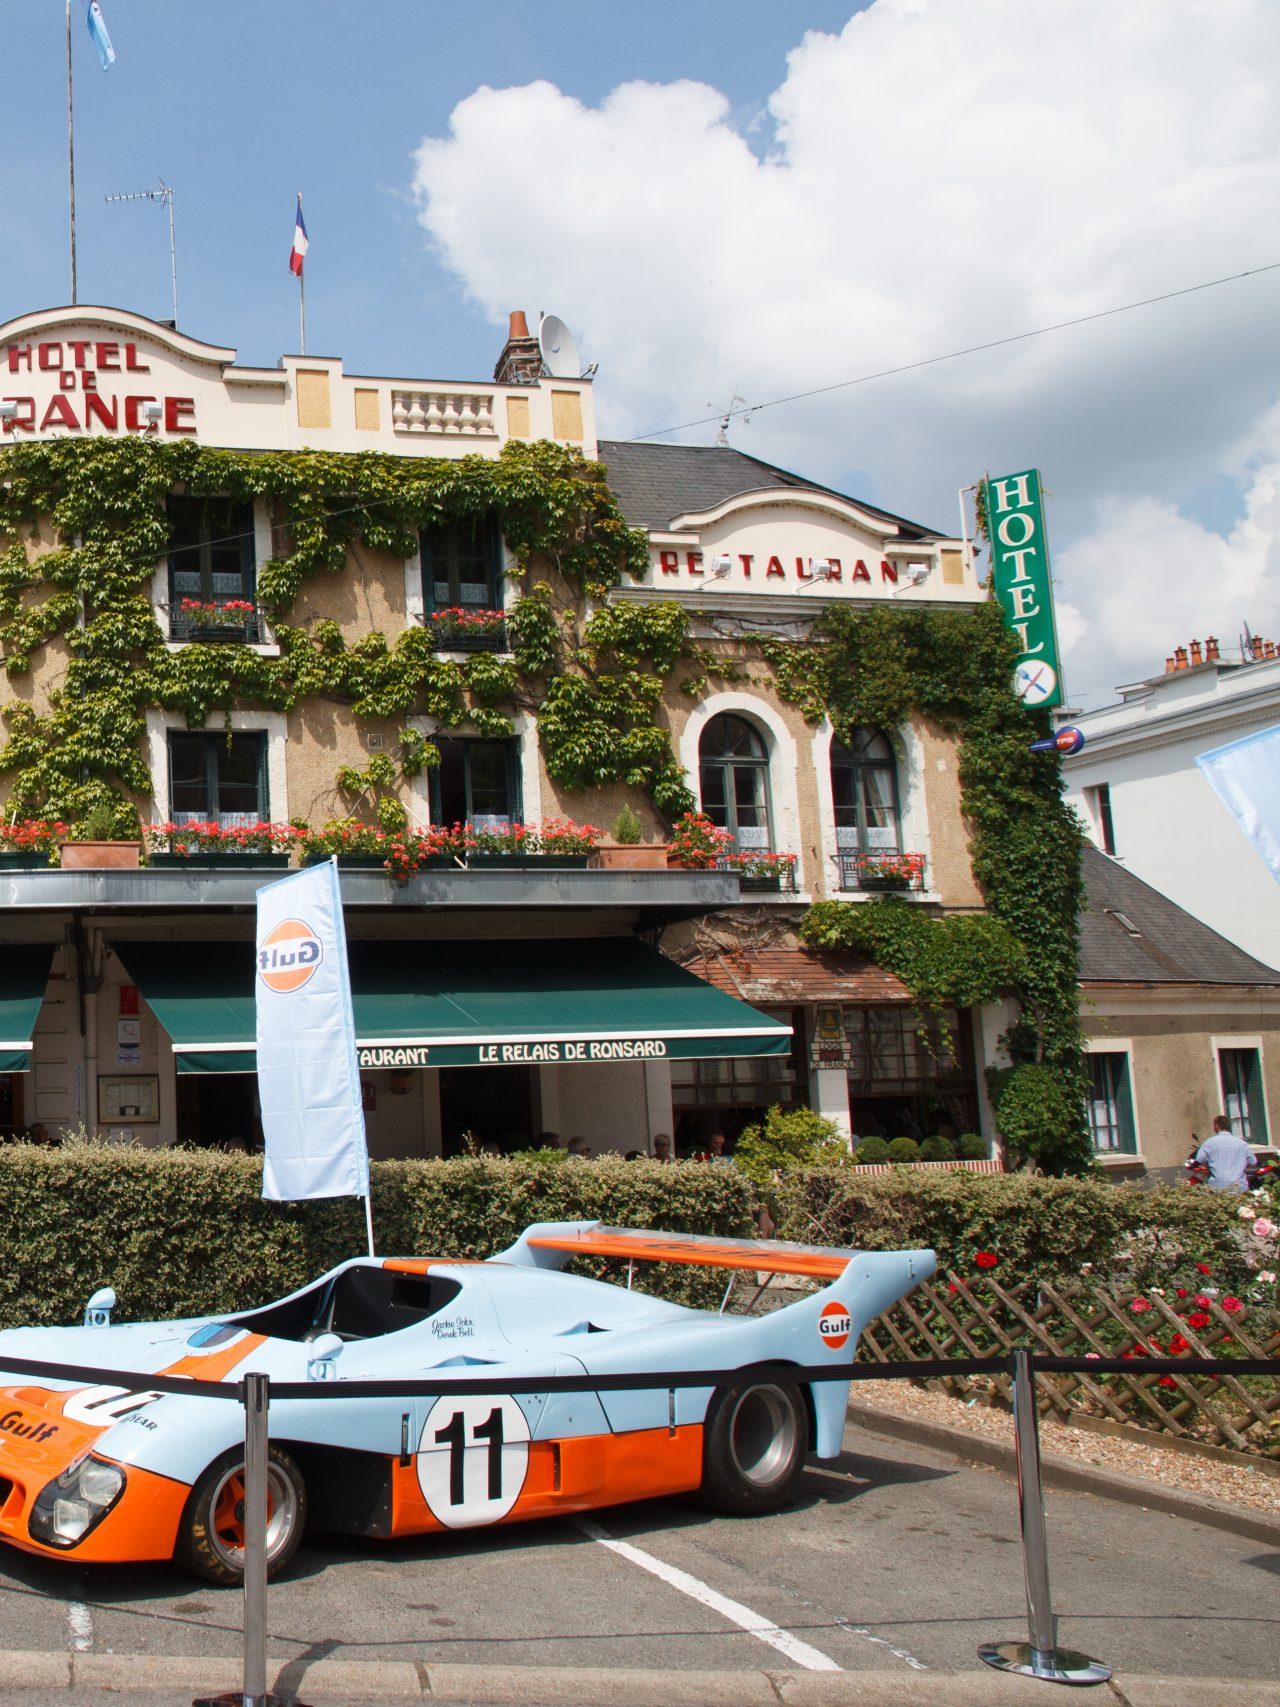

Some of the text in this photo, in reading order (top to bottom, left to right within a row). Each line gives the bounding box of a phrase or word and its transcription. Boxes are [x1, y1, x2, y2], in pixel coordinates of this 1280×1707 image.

[8, 341, 149, 371] HOTEL
[60, 371, 96, 389] DE
[660, 551, 931, 583] RETAURAN
[992, 474, 1044, 655] HOTEL
[358, 1048, 428, 1066] AURANT
[479, 1040, 667, 1062] LE RELAIS DE RONSARD
[819, 1318, 851, 1334] Gulf
[435, 1407, 504, 1506] 11
